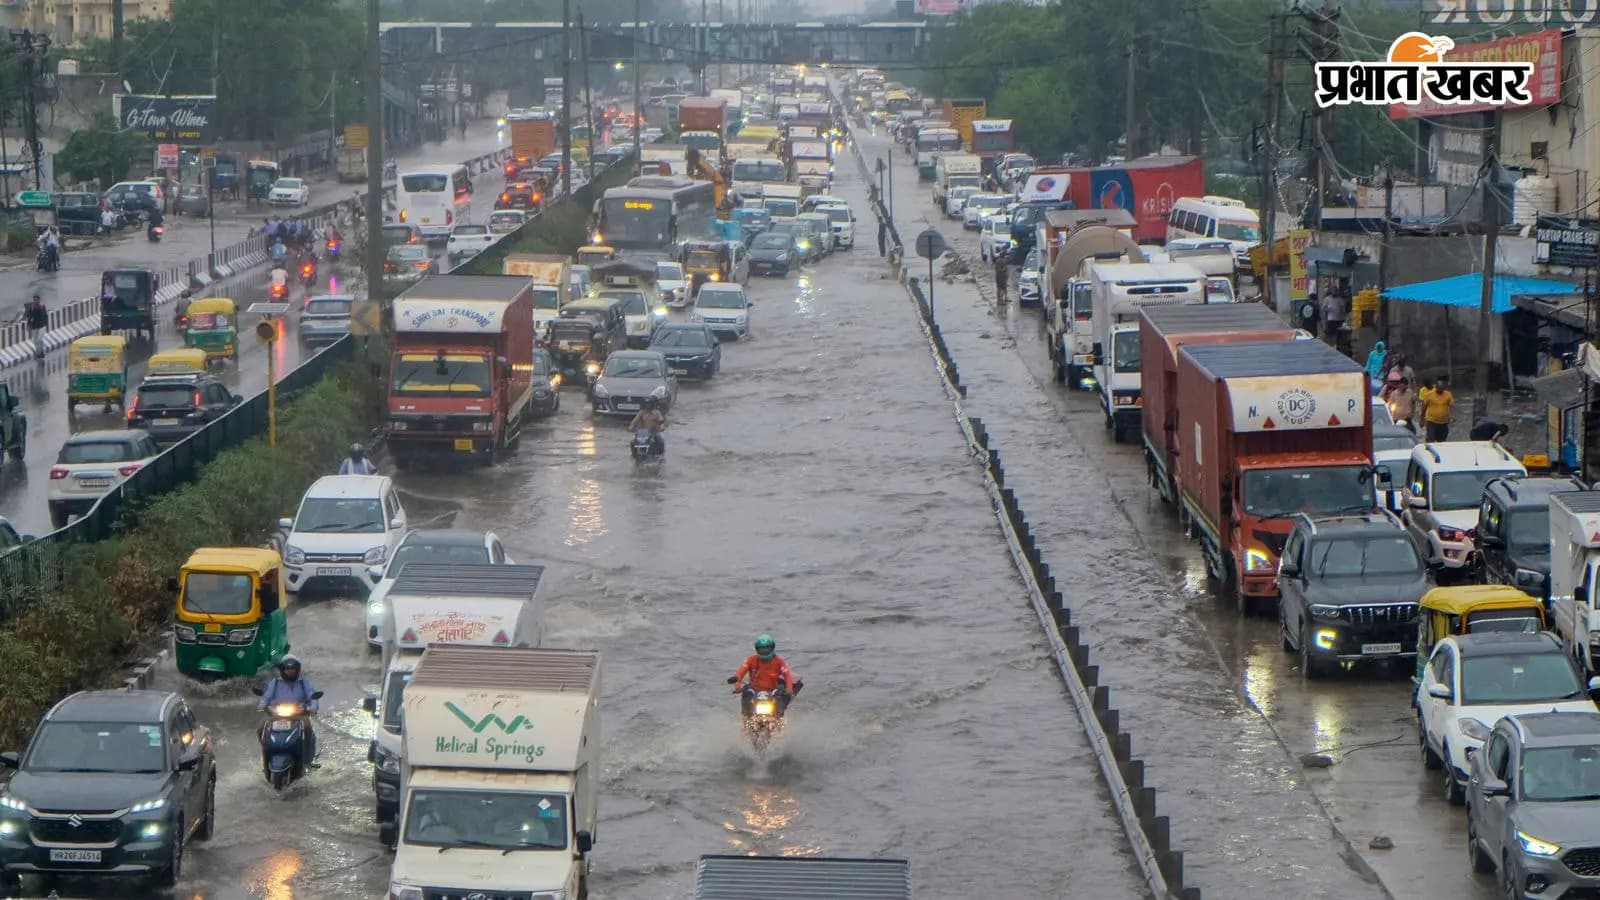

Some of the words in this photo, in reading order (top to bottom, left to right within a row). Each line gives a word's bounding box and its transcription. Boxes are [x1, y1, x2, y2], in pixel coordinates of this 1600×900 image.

[169, 108, 208, 127] Wines
[1289, 399, 1305, 411] DC
[436, 735, 478, 753] Helical
[485, 736, 545, 763] Springs
